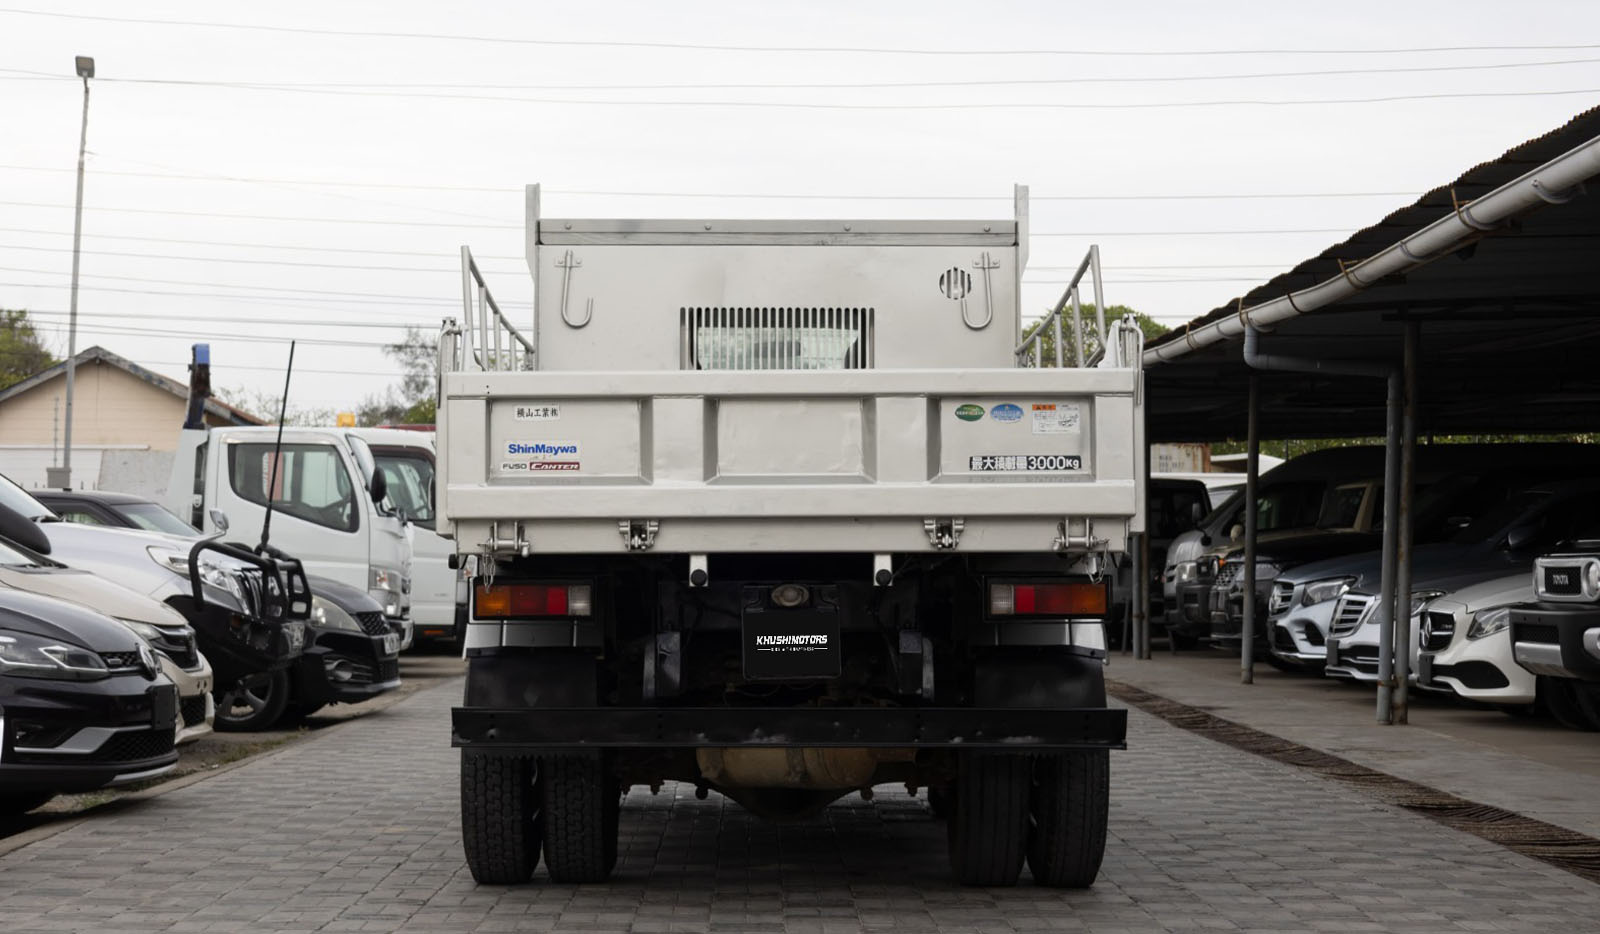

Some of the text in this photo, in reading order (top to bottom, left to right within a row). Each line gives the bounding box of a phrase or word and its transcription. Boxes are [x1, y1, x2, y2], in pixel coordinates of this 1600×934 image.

[508, 443, 577, 455] ShinMaywa
[530, 462, 579, 471] CANTER
[1552, 574, 1569, 585] TOYOTA
